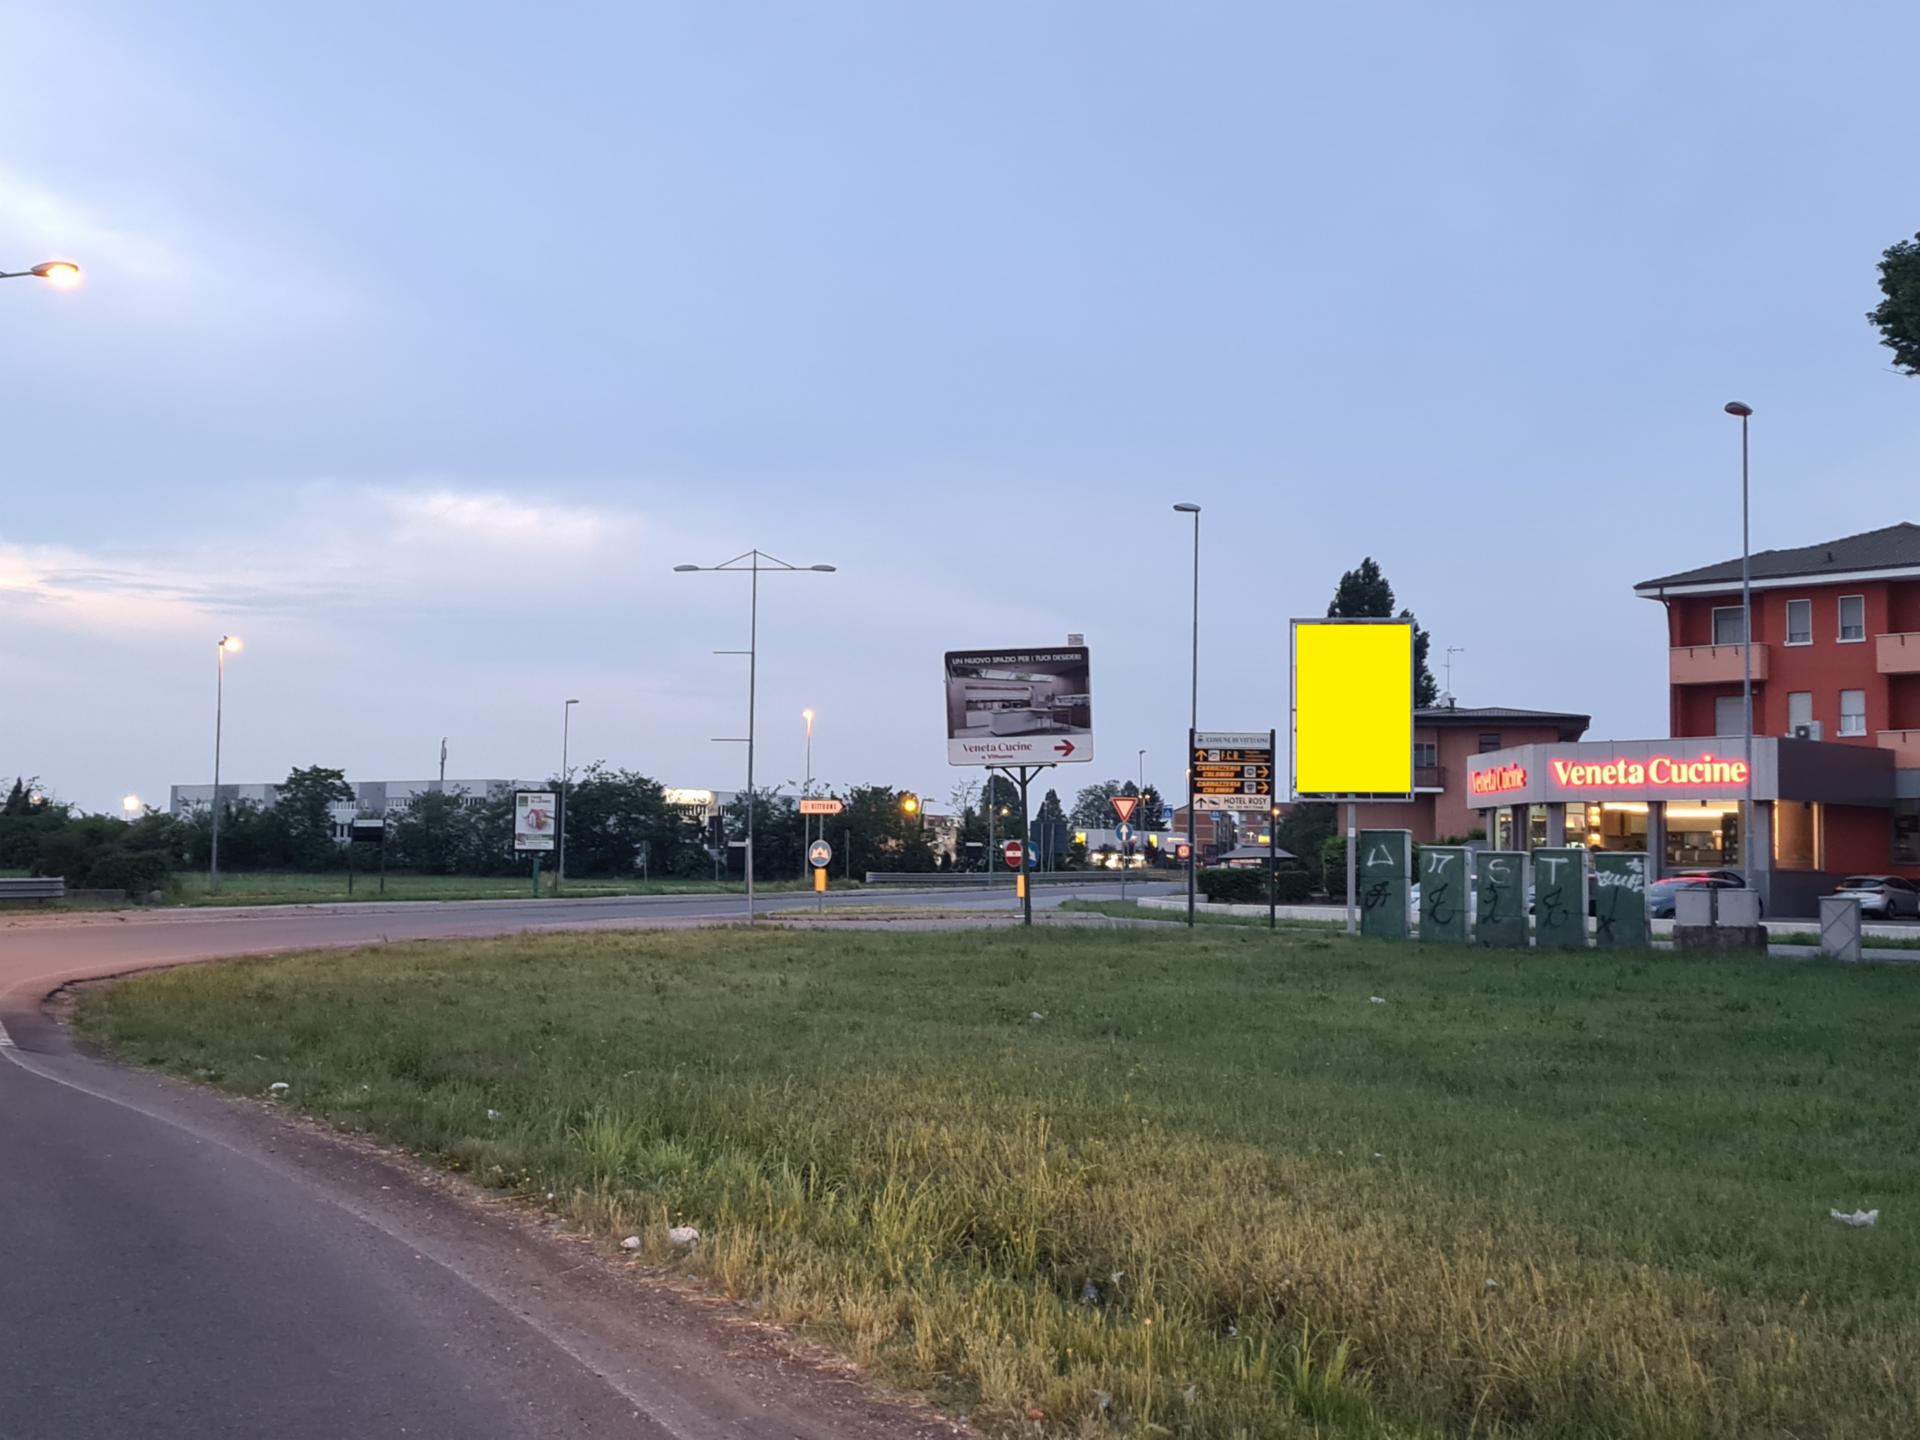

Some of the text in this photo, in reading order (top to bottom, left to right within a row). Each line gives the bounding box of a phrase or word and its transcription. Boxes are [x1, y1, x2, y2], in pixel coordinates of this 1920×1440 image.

[964, 656, 991, 664] NUOVO
[992, 655, 1016, 663] SPAZIO
[1035, 654, 1051, 662] TUOI
[962, 741, 1033, 752] Veneta Cucine
[1553, 754, 1747, 786] Veneta Cucine
[1224, 796, 1268, 805] HOTEL ROSY
